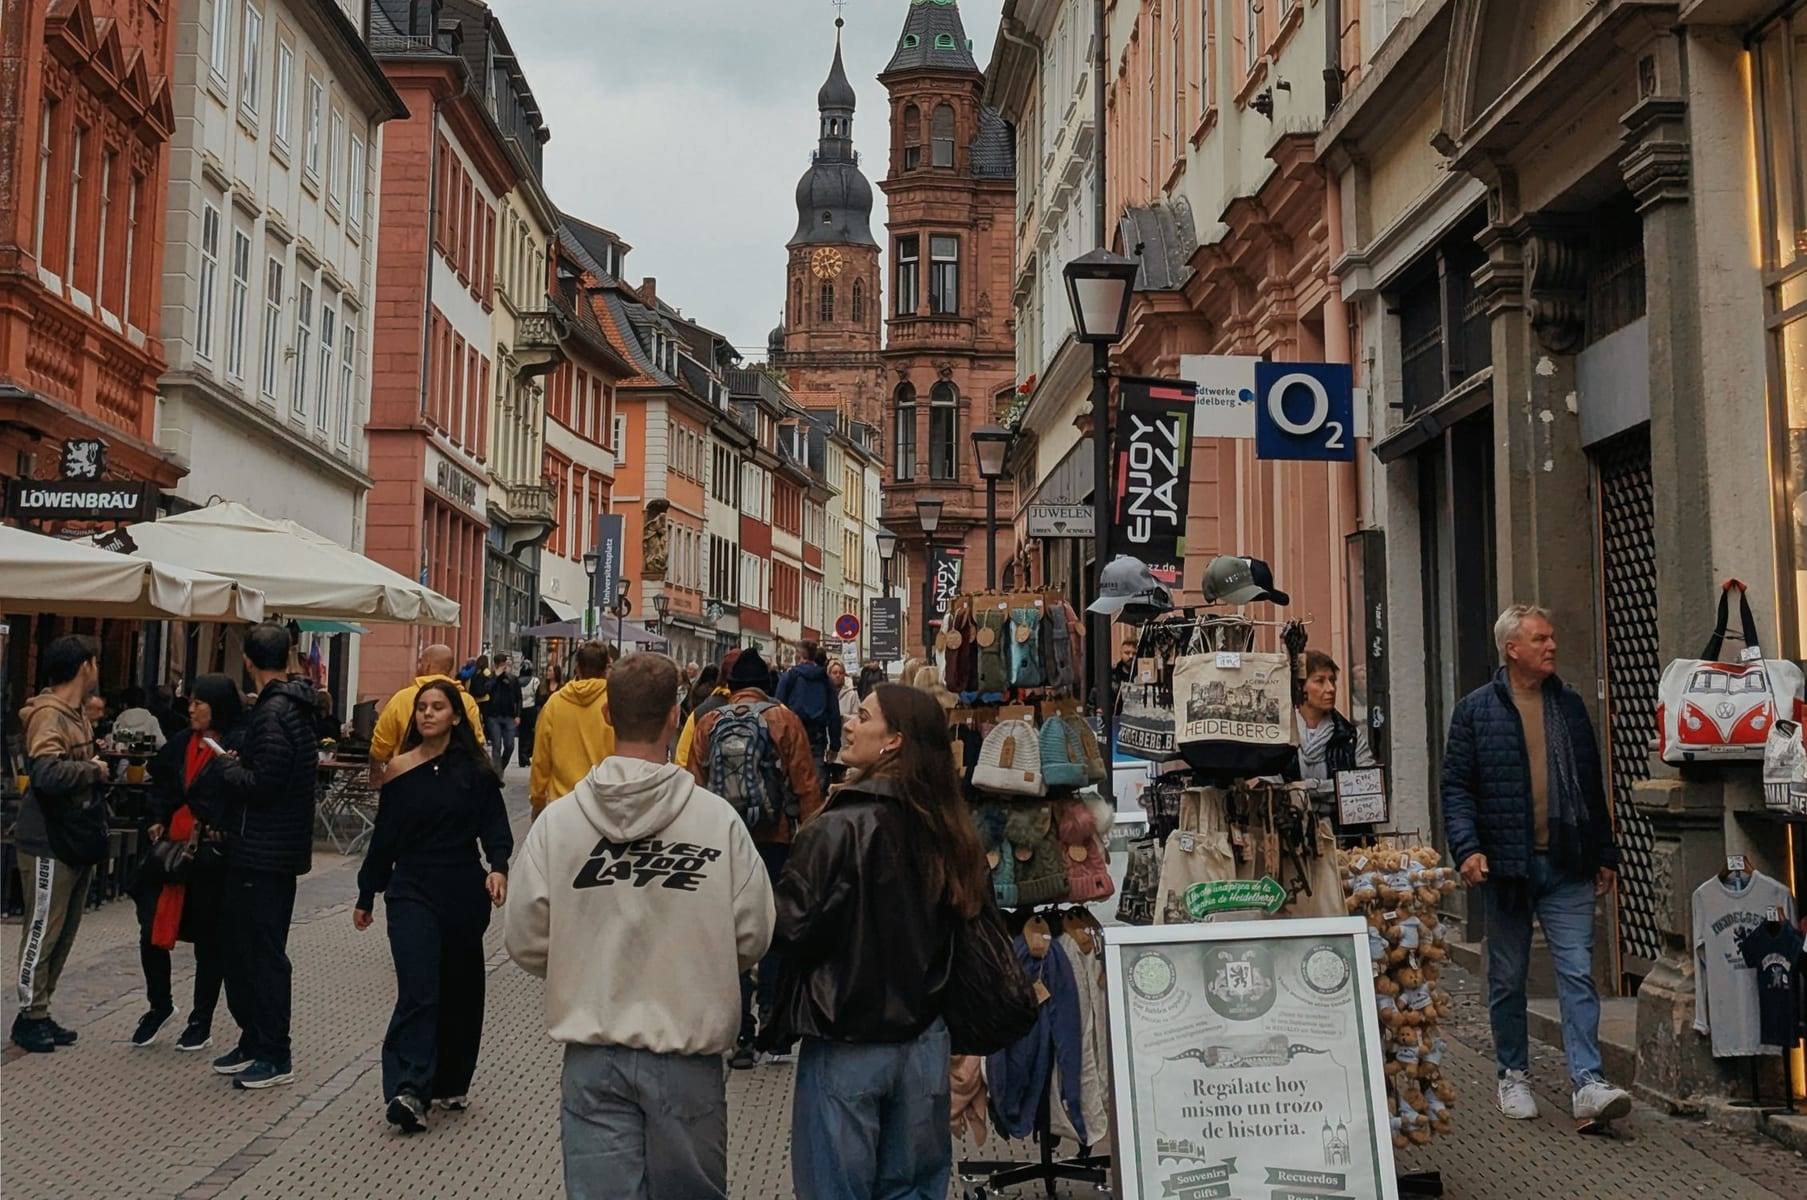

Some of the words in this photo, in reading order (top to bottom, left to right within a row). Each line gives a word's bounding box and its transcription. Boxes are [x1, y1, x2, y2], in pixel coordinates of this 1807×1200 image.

[1127, 414, 1154, 543] ENJOY
[1153, 419, 1180, 526] JAZZ
[20, 490, 138, 509] LÖWENBRÄU
[1032, 508, 1093, 519] JUWELEN
[603, 538, 614, 604] Universitätsplatz
[947, 562, 959, 597] AZZ
[936, 560, 948, 613] ENJOY
[1185, 720, 1280, 739] HEIDELBERG
[590, 835, 722, 863] NEVER
[628, 852, 706, 872] TOO
[572, 857, 708, 891] LATE
[1192, 1077, 1271, 1101] Regálate
[1275, 1075, 1309, 1097] hoy
[1181, 1101, 1243, 1118] mismo
[1247, 1102, 1271, 1116] un
[1275, 1100, 1323, 1115] trozo
[1202, 1123, 1224, 1139] de
[1228, 1119, 1306, 1139] historia.
[1176, 1168, 1227, 1185] Souvenirs
[1277, 1170, 1339, 1186] Recuerdos
[1192, 1187, 1218, 1200] Gifts
